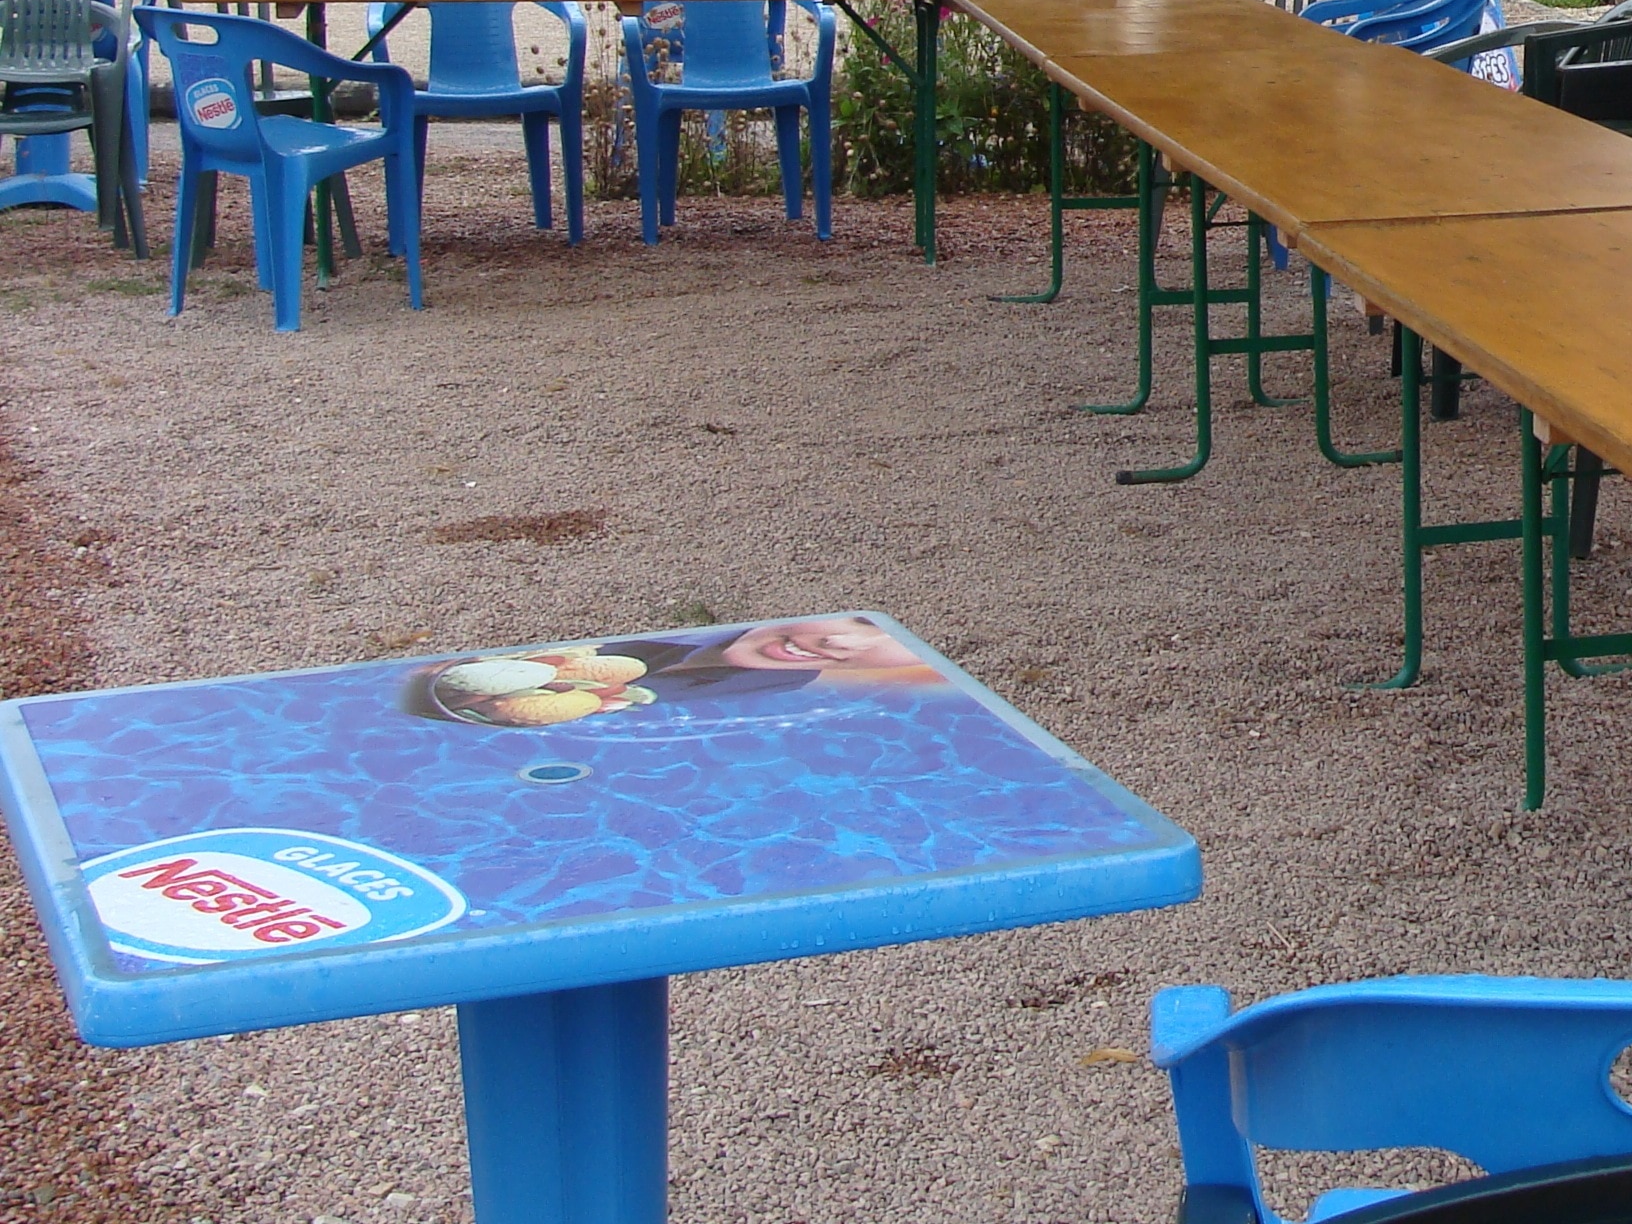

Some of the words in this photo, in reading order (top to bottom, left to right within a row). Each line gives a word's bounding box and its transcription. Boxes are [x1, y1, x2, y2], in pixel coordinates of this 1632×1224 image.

[197, 98, 235, 122] Nestlé
[117, 858, 348, 943] Nestlé
[273, 845, 415, 902] GLACES
